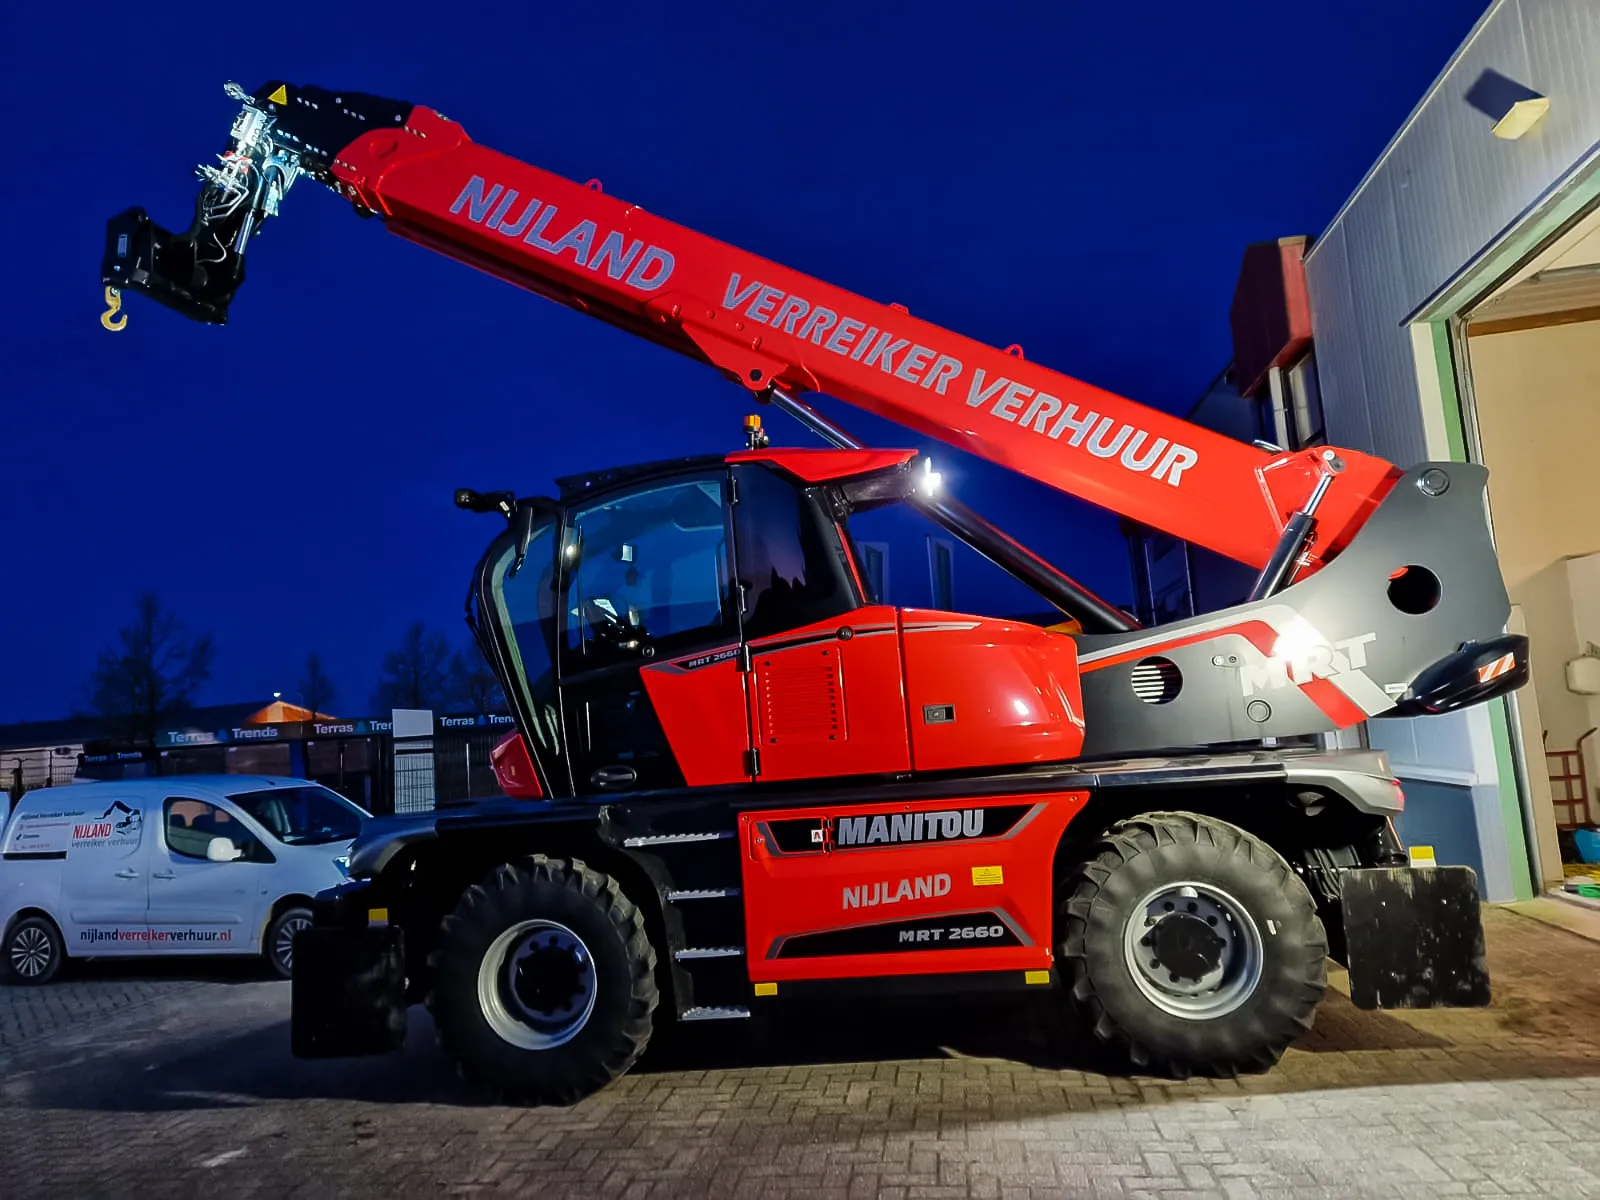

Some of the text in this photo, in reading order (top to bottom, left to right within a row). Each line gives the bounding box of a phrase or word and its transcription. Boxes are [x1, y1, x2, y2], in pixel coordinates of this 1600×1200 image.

[449, 175, 675, 291] NIJLAND
[721, 273, 1198, 486] VERREIKER VERHUUR
[688, 655, 711, 668] MRT
[1239, 632, 1376, 697] MRT
[440, 714, 515, 727] Terras Tren
[168, 727, 279, 743] Terras Trends
[313, 723, 354, 735] Terras
[72, 823, 112, 839] NIJLAND
[838, 809, 985, 846] MANITOU
[71, 840, 104, 849] verreiker
[842, 873, 951, 909] NIJLAND
[80, 928, 232, 944] nijlandverreikerverhuur.nl
[899, 925, 1004, 943] MRT 2660
